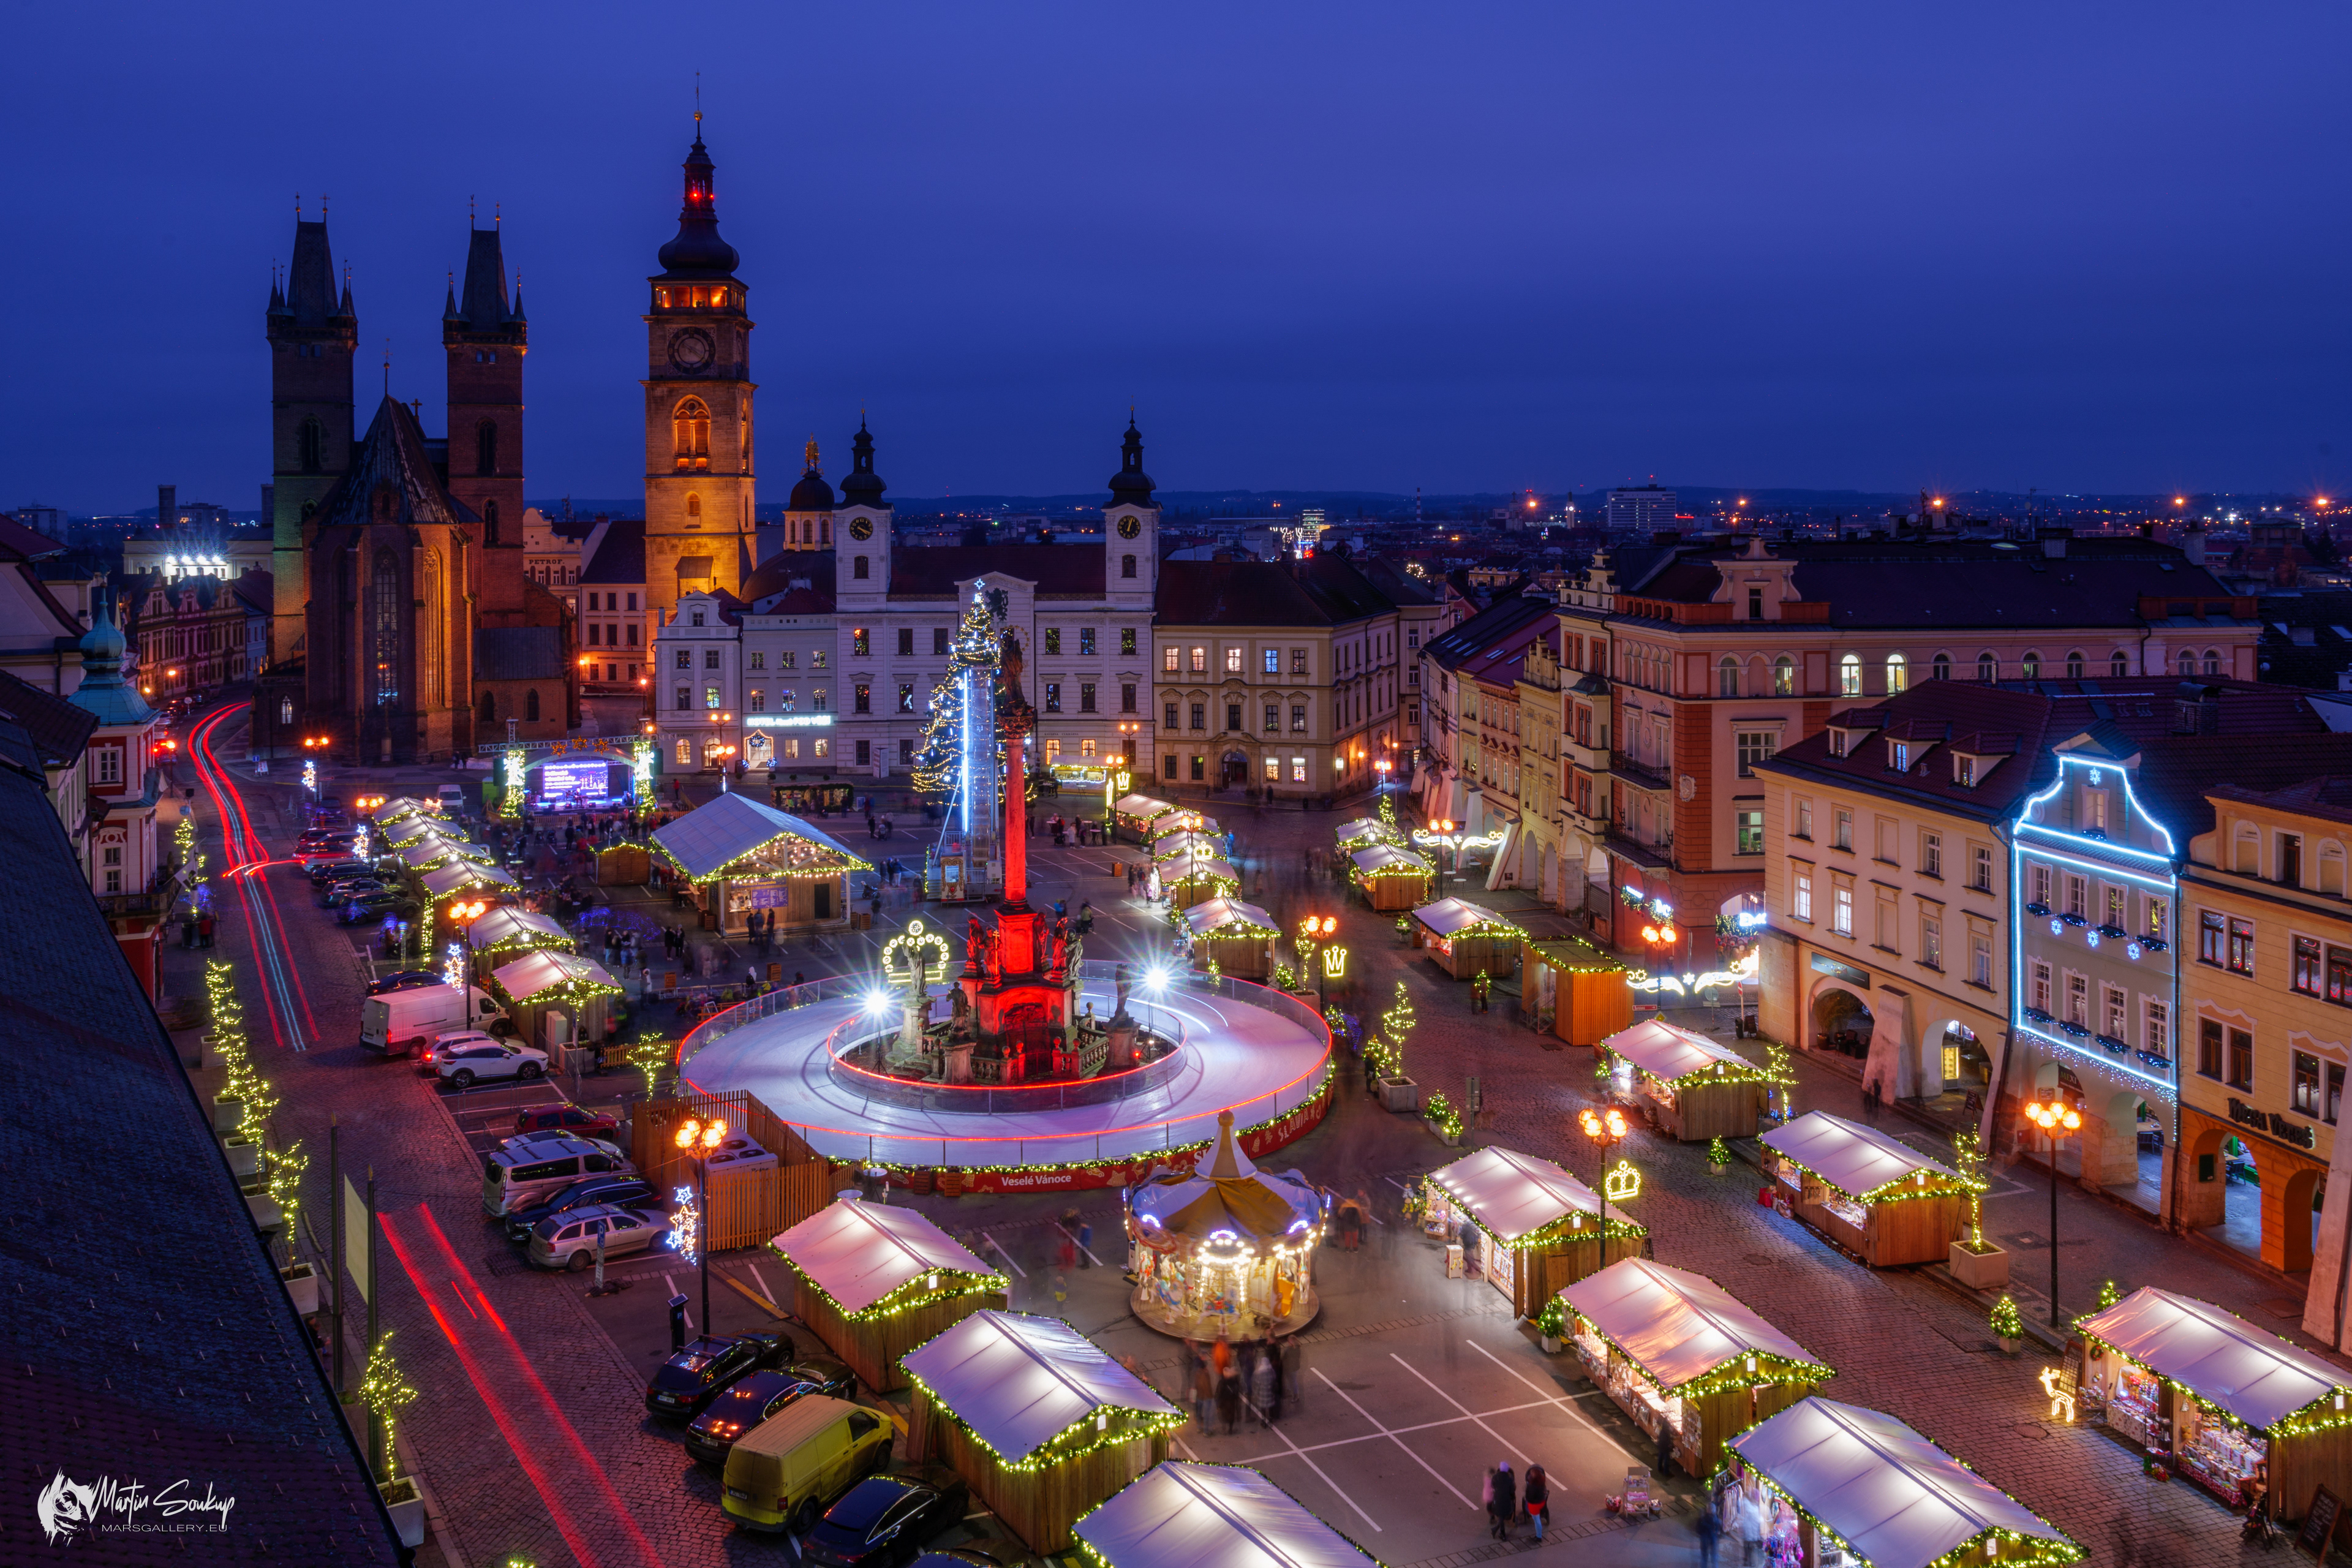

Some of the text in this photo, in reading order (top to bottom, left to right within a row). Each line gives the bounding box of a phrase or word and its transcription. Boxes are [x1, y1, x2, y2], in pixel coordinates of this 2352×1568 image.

[2060, 1071, 2079, 1086] MEXI
[1001, 1174, 1072, 1186] Veselé Vánoce
